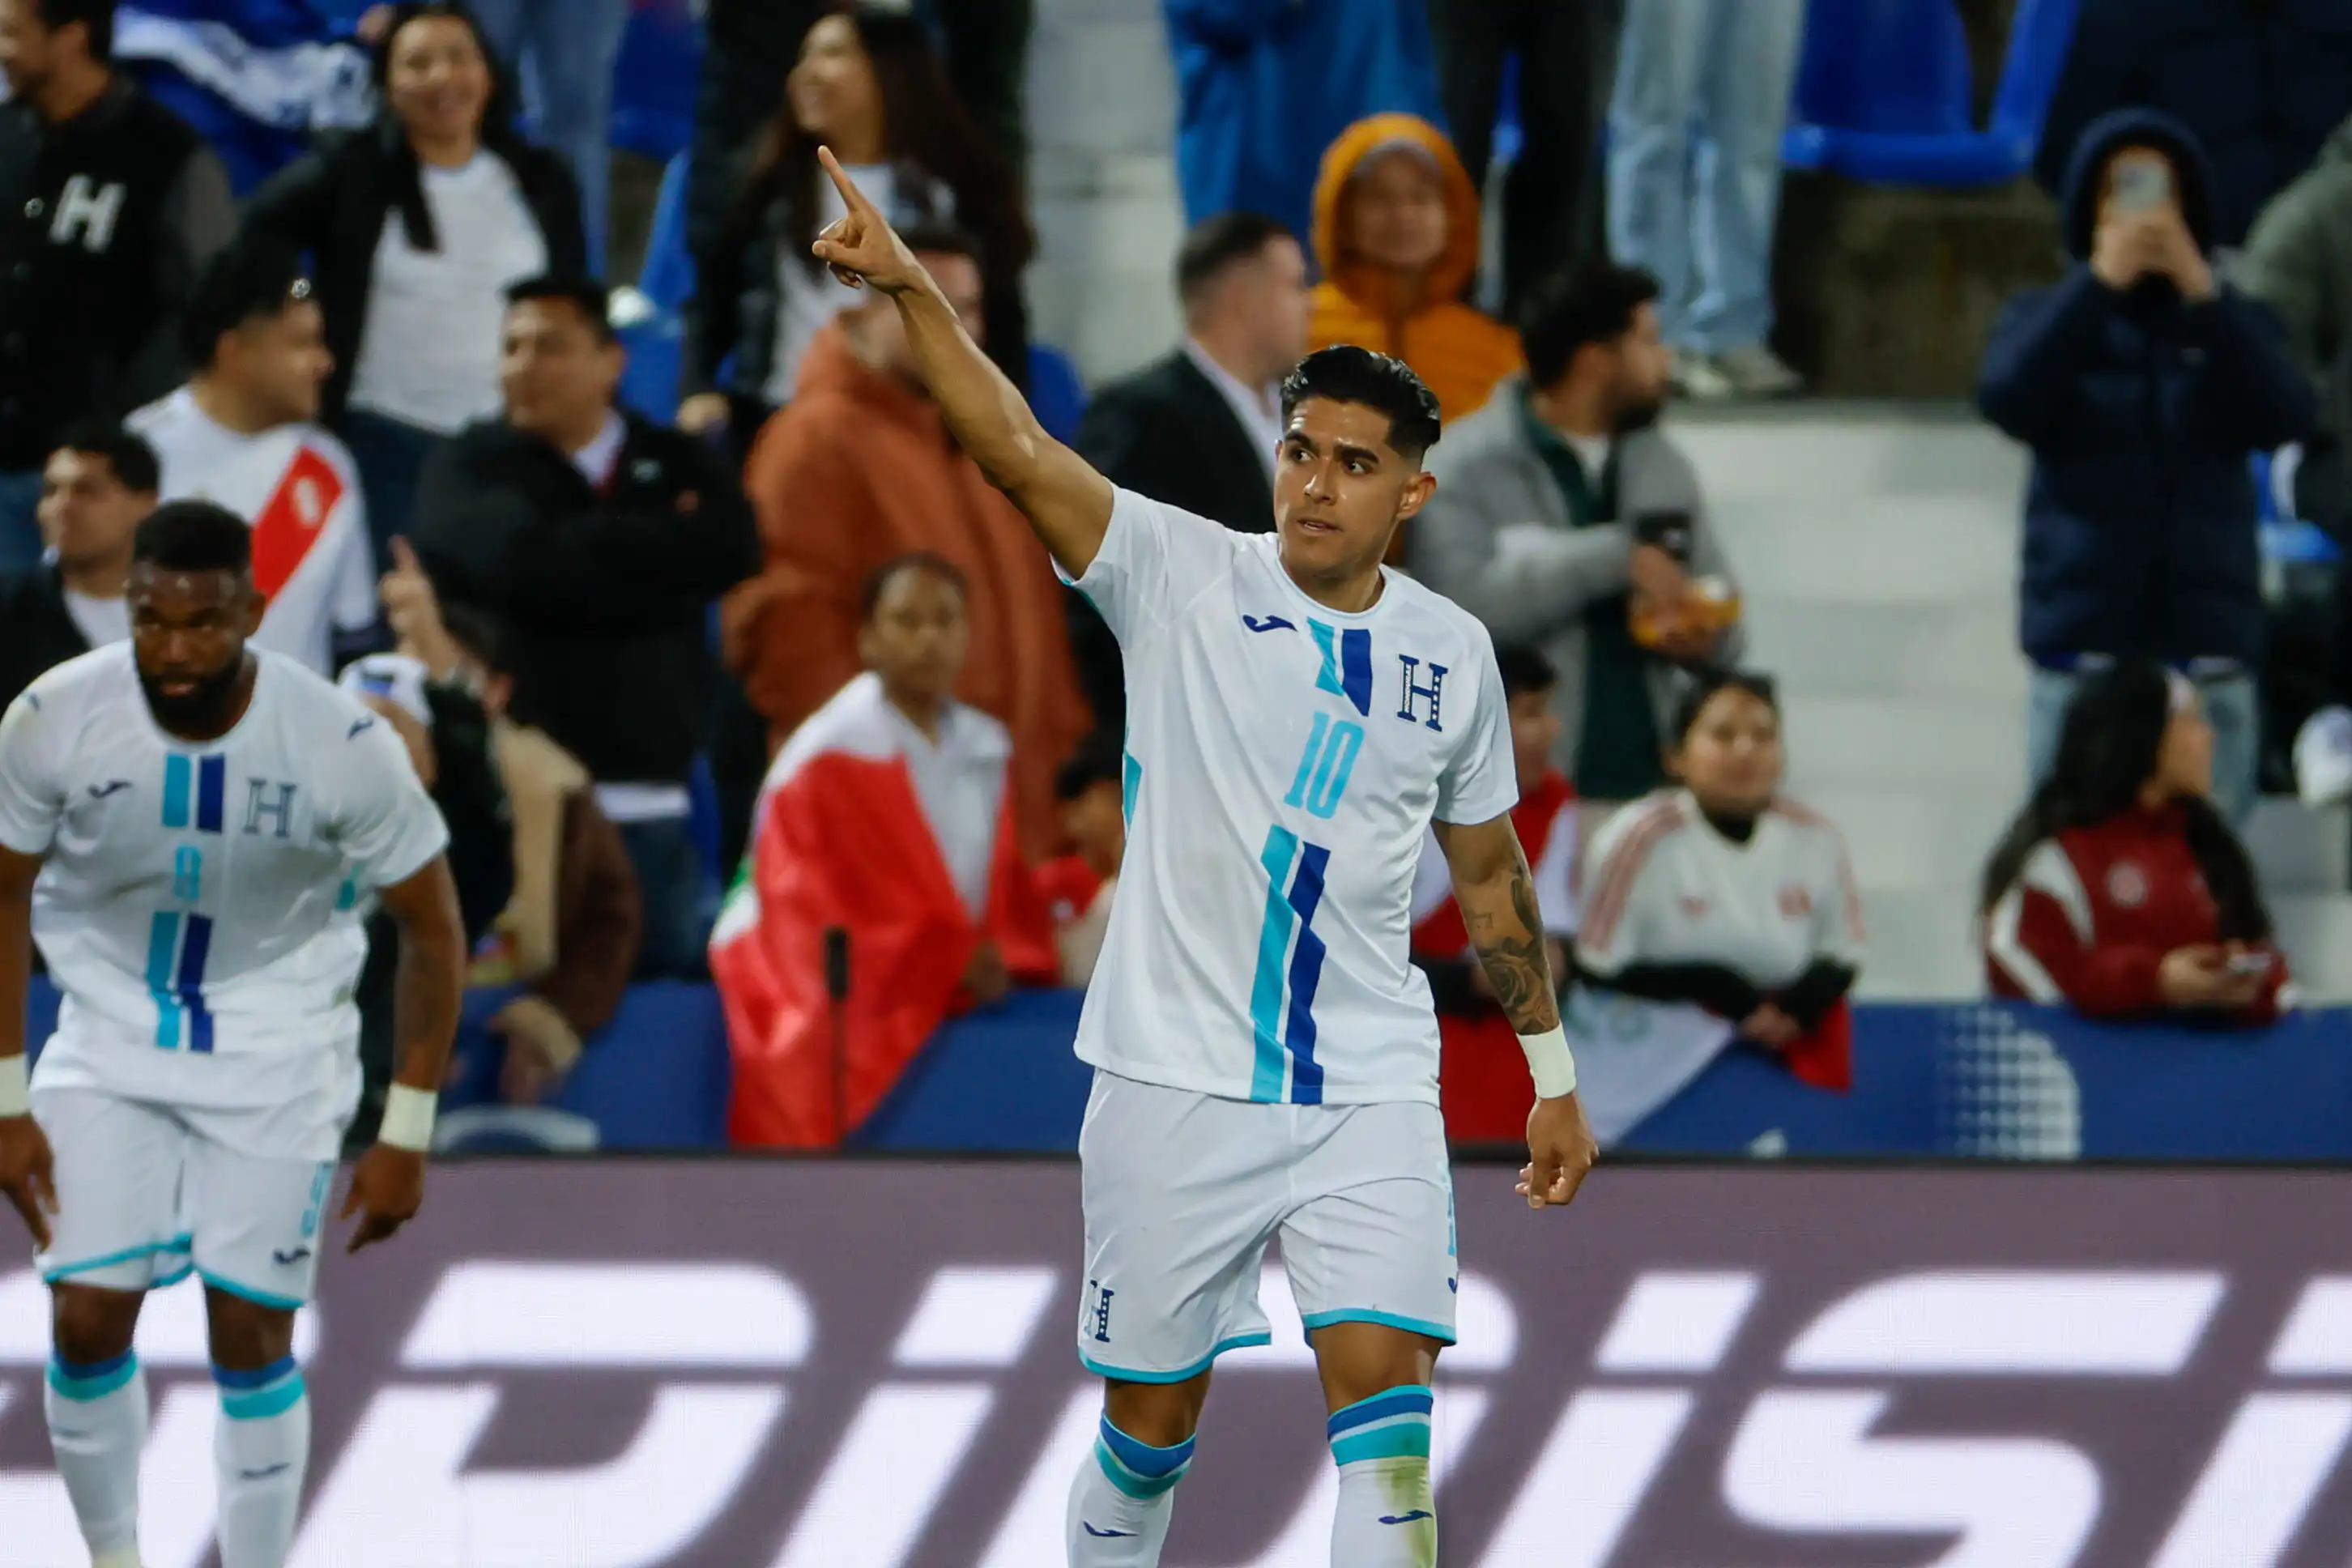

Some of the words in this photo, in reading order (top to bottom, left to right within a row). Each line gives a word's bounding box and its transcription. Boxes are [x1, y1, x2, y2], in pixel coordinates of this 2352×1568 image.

[51, 173, 127, 253] H
[1397, 653, 1448, 732] H
[1283, 710, 1365, 820] 10
[243, 777, 298, 837] H
